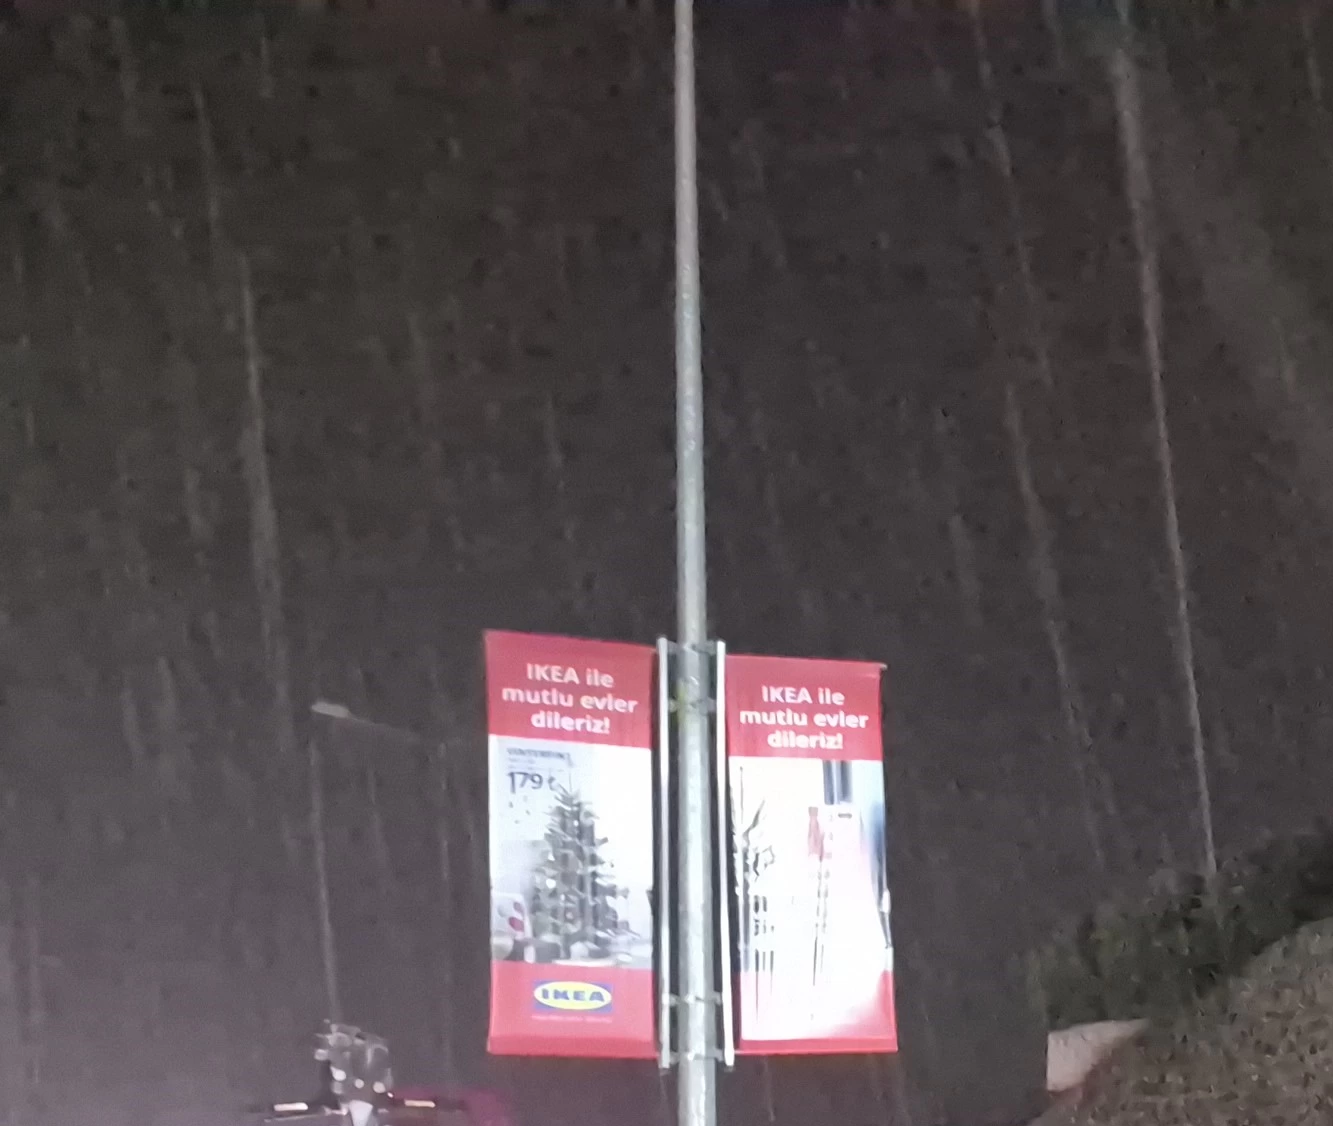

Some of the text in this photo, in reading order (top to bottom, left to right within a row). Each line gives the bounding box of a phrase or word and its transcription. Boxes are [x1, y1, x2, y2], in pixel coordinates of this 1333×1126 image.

[526, 663, 615, 688] IKEA ile
[501, 687, 638, 713] mutlu evler
[761, 684, 846, 706] IKEA ile
[530, 709, 611, 735] dileriz!
[739, 707, 870, 729] mutlu evler
[766, 729, 844, 750] dileriz!
[507, 771, 544, 794] 179
[541, 988, 605, 1003] IKEA
